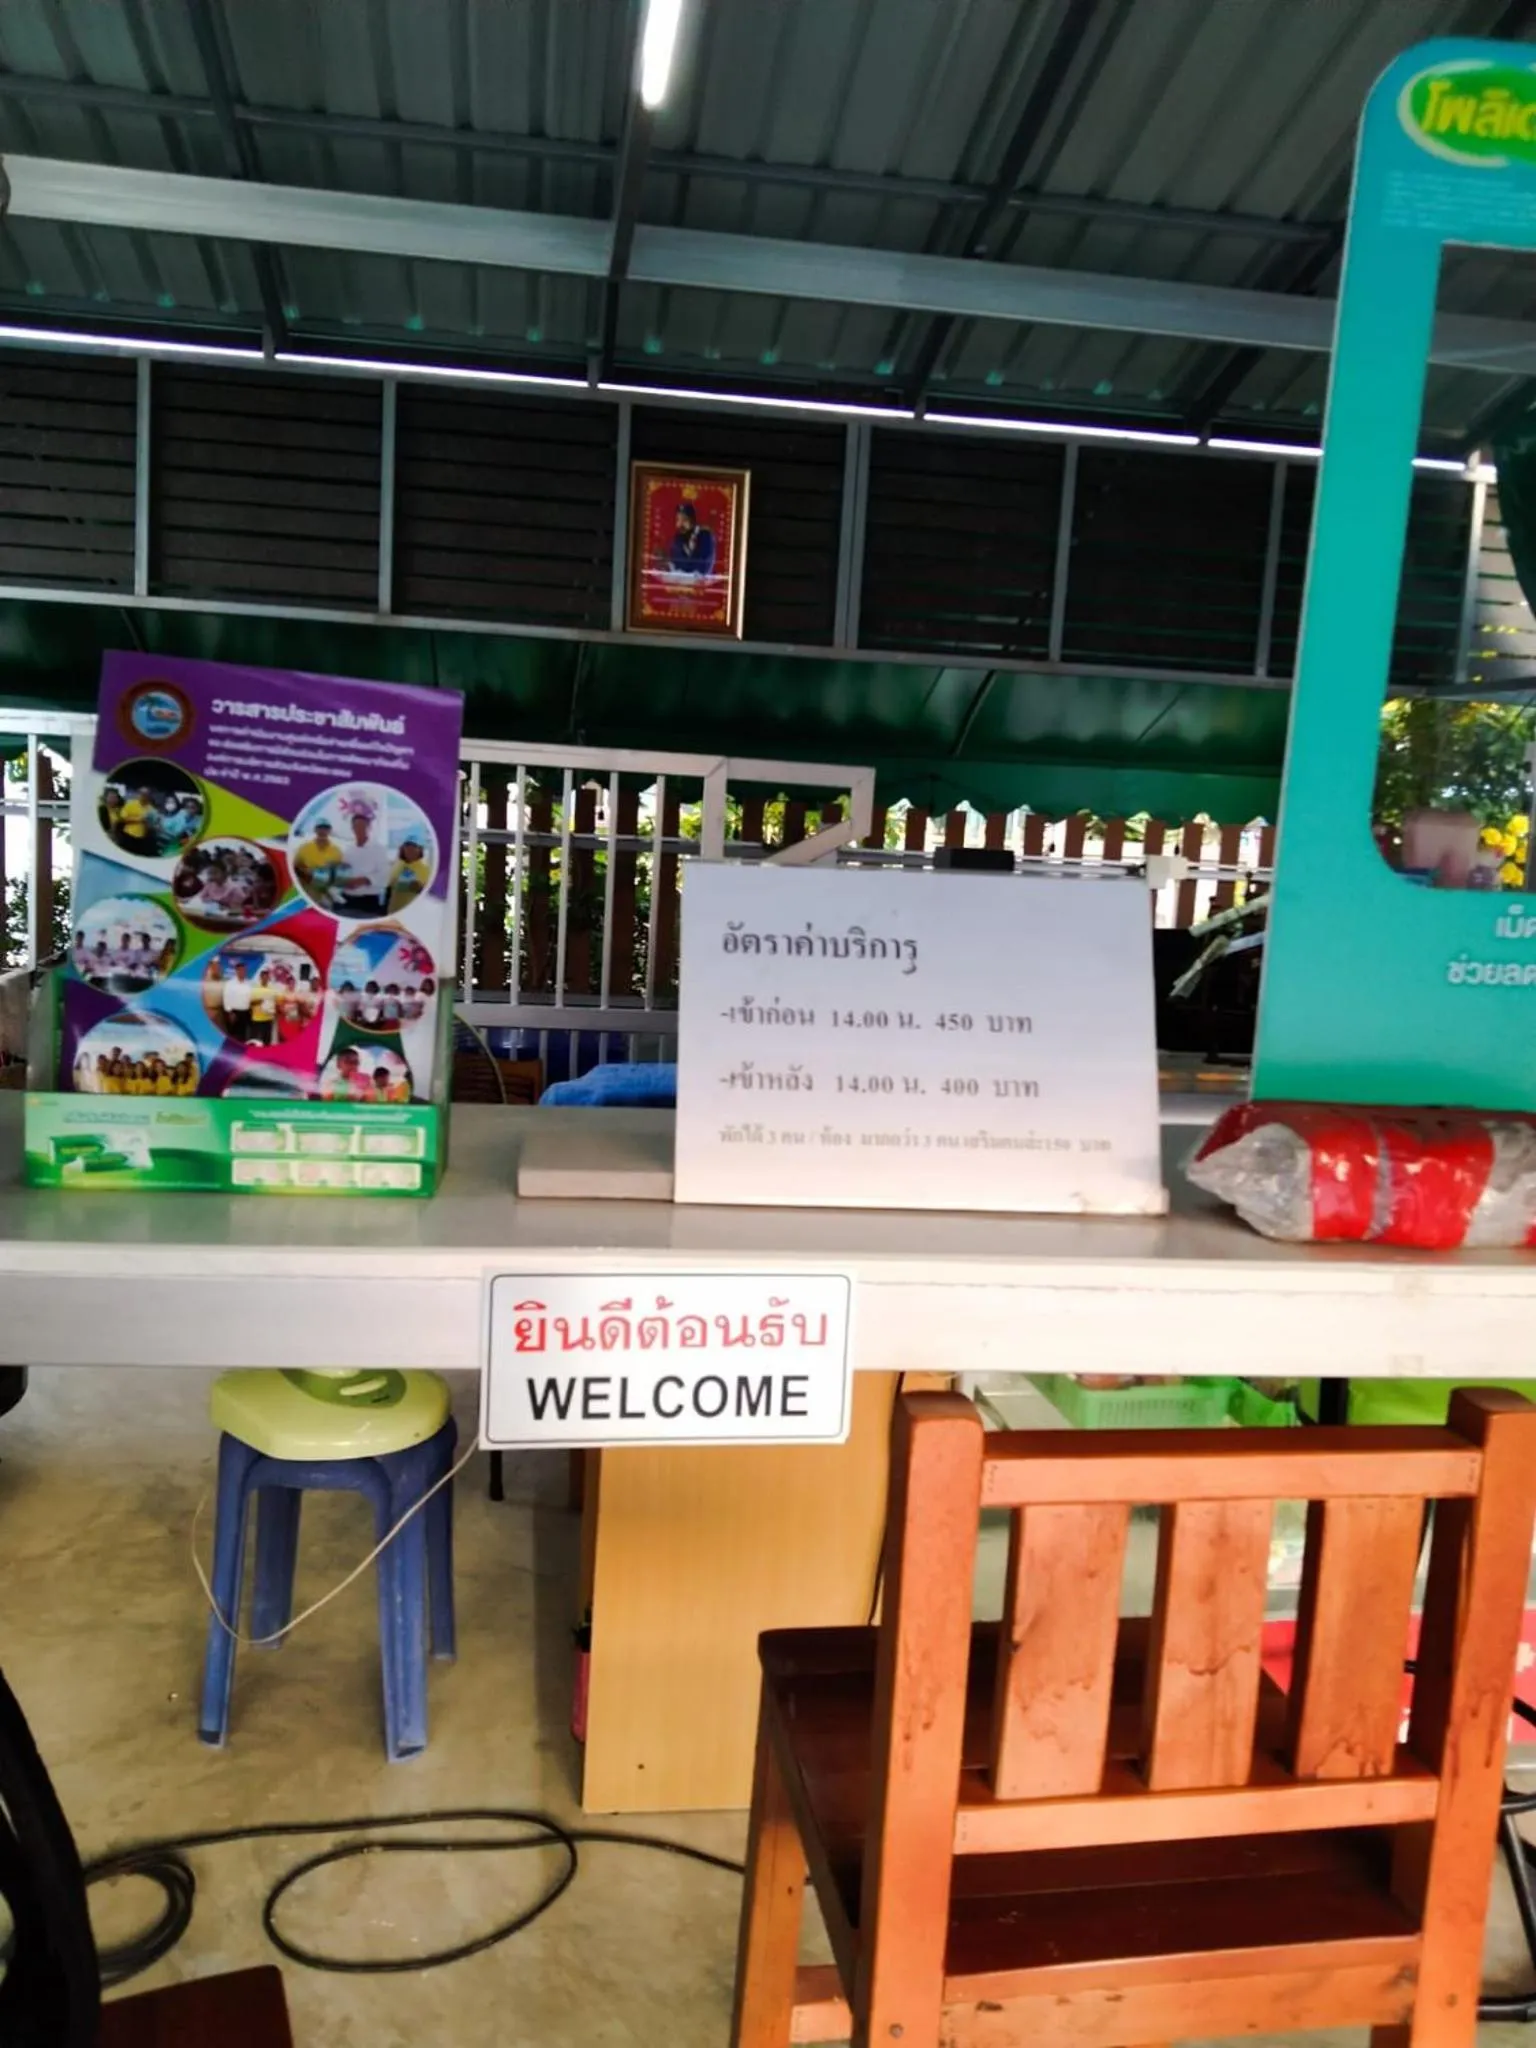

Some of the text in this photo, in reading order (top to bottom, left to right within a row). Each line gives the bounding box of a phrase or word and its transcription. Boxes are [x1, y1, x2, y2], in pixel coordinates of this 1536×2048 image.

[831, 1008, 889, 1029] 14.00
[898, 1011, 922, 1031] น.
[935, 1013, 974, 1032] 450
[987, 1013, 1033, 1035] บาท
[835, 1075, 894, 1094] 14.00
[940, 1078, 979, 1097] 400
[993, 1078, 1040, 1099] บาท
[512, 1295, 828, 1353] ยินดีต้อนรับ
[526, 1374, 810, 1421] WELCOME
